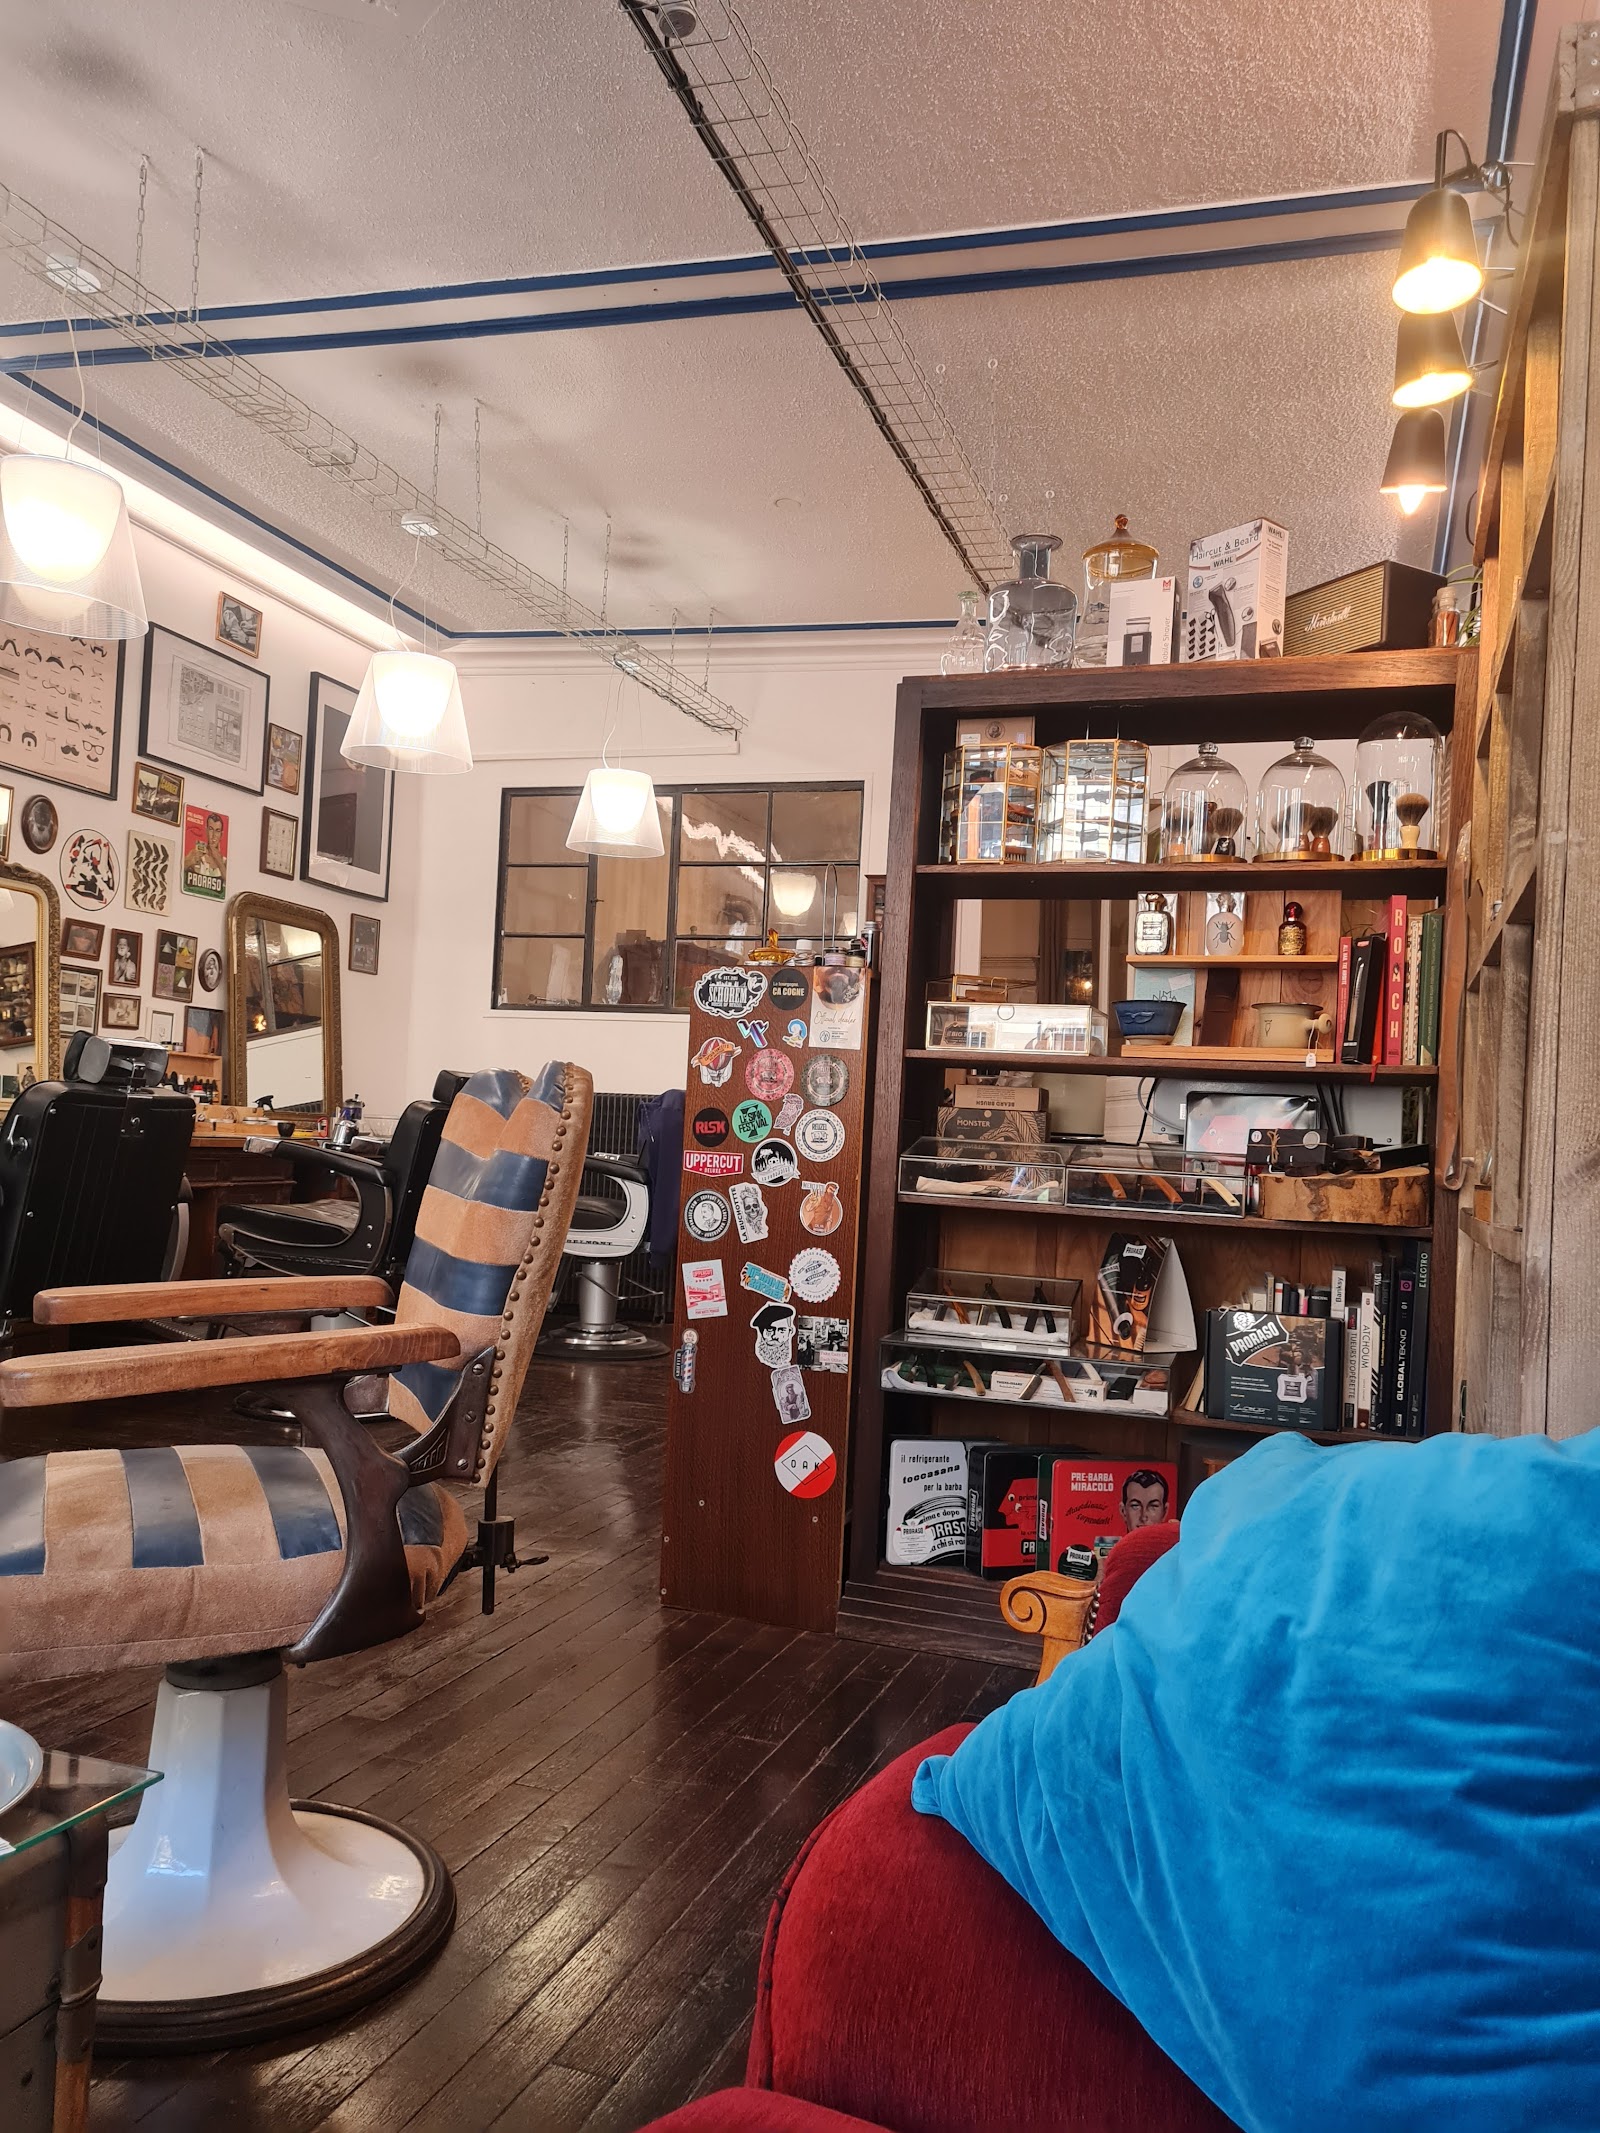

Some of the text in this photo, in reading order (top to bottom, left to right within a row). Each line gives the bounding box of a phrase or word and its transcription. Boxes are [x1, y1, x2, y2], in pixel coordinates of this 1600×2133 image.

[1268, 526, 1283, 539] WAHL
[1192, 533, 1259, 562] Haircut & Beard
[1213, 556, 1233, 568] WAHL
[1304, 605, 1351, 632] Marshall
[187, 872, 222, 891] PRORASO
[1389, 908, 1403, 1039] ROACH
[708, 986, 748, 1004] SCHOREM
[772, 987, 805, 997] CA COGNE
[695, 1121, 727, 1135] RISK
[738, 1117, 769, 1134] FESTIVAL
[956, 1119, 991, 1128] MONSTER
[685, 1153, 741, 1172] UPPERCUT
[730, 1187, 748, 1242] LA RUCHOTTE
[1126, 1246, 1145, 1256] PRORASO
[1418, 1252, 1429, 1289] ELECTRO
[1335, 1276, 1343, 1303] Banksy
[1401, 1301, 1408, 1310] 01
[1229, 1321, 1280, 1357] PRORASO
[1350, 1332, 1358, 1359] TUEURS
[1361, 1324, 1371, 1369] ATCHOUM
[1396, 1328, 1408, 1401] GLOBALTEKNO
[901, 1454, 950, 1465] il refrigerante
[902, 1464, 961, 1484] toccasana
[1071, 1472, 1114, 1482] PRE-BARBA
[923, 1482, 963, 1493] per la barba
[1071, 1482, 1114, 1492] MIRACOLO
[942, 1508, 960, 1517] dopo
[968, 1493, 977, 1527] PRORASO
[903, 1527, 924, 1535] PRORASO
[1069, 1551, 1090, 1562] PRORASO
